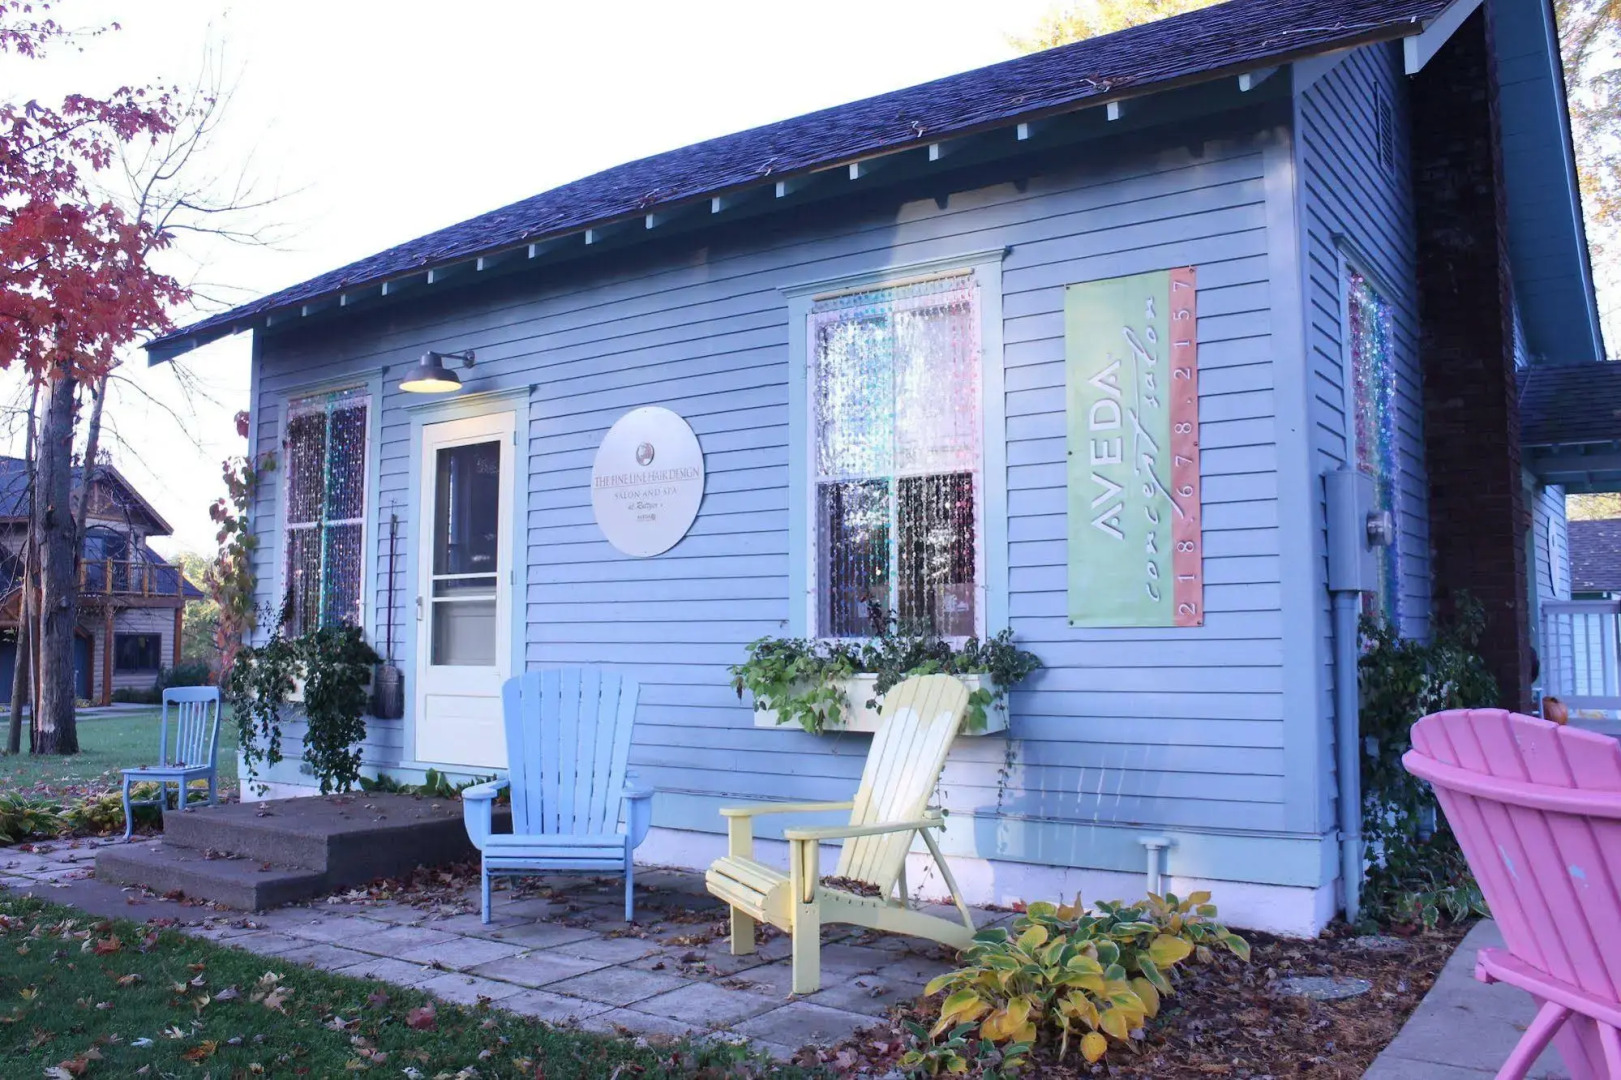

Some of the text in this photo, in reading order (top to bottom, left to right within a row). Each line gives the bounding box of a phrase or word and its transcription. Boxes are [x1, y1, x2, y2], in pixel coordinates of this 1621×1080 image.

[595, 467, 700, 487] THE FINE LINE HAIR DESIGN
[614, 487, 678, 500] SALON AND SPA
[1088, 360, 1124, 541] AVEDA
[1122, 296, 1184, 602] concept salon
[1172, 280, 1196, 616] 218.678.2157
